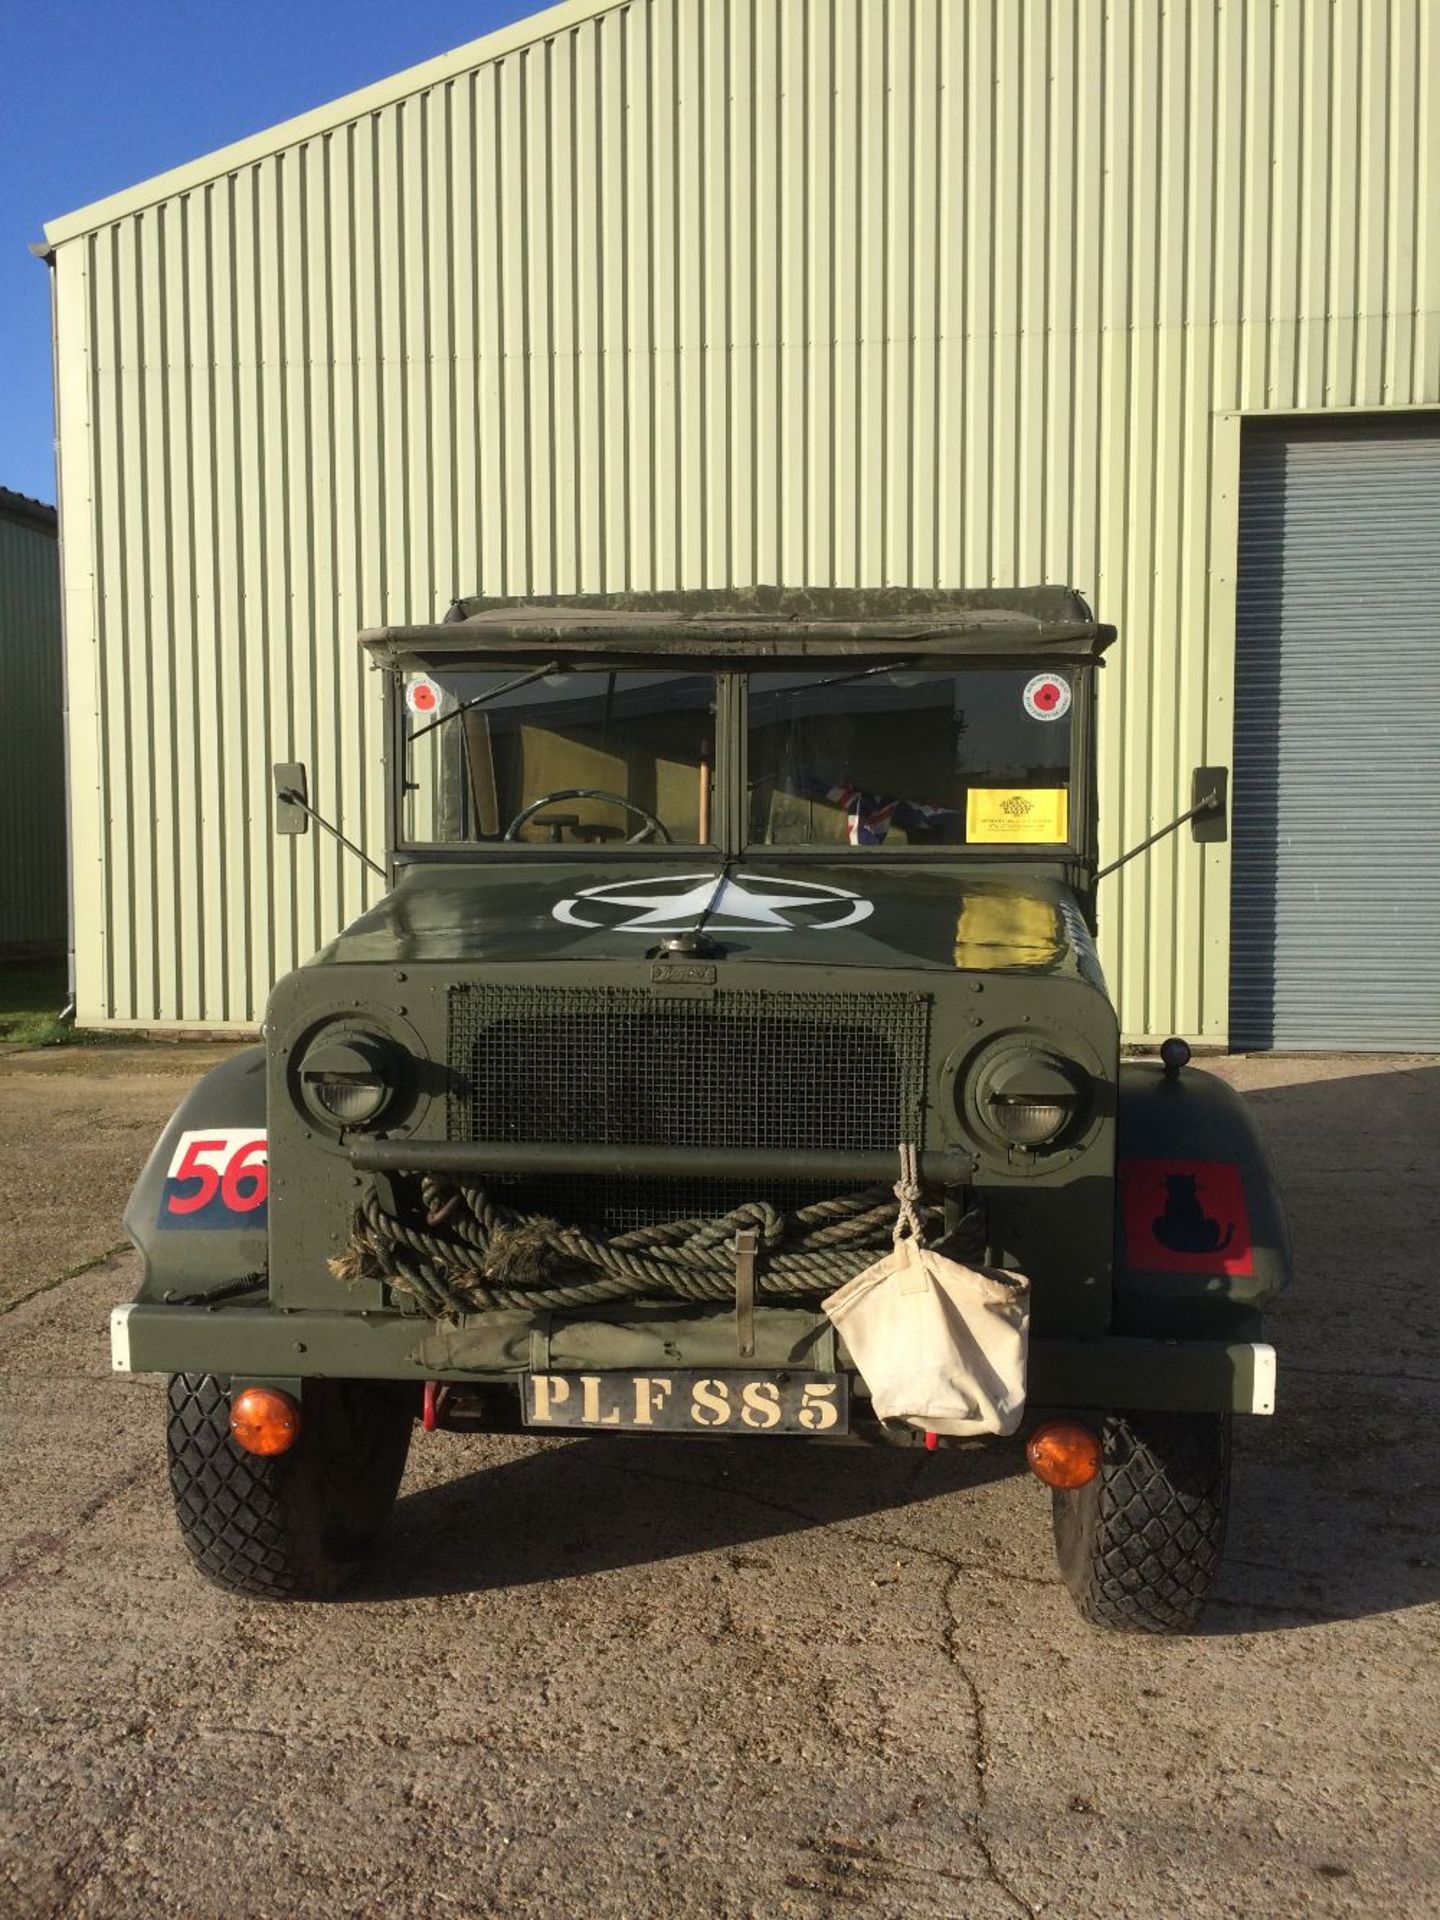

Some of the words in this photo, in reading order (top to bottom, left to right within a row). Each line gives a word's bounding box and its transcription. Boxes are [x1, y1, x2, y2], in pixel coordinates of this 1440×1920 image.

[168, 1140, 269, 1215] 56
[531, 1376, 672, 1425] PLF
[691, 1379, 838, 1430] 885
